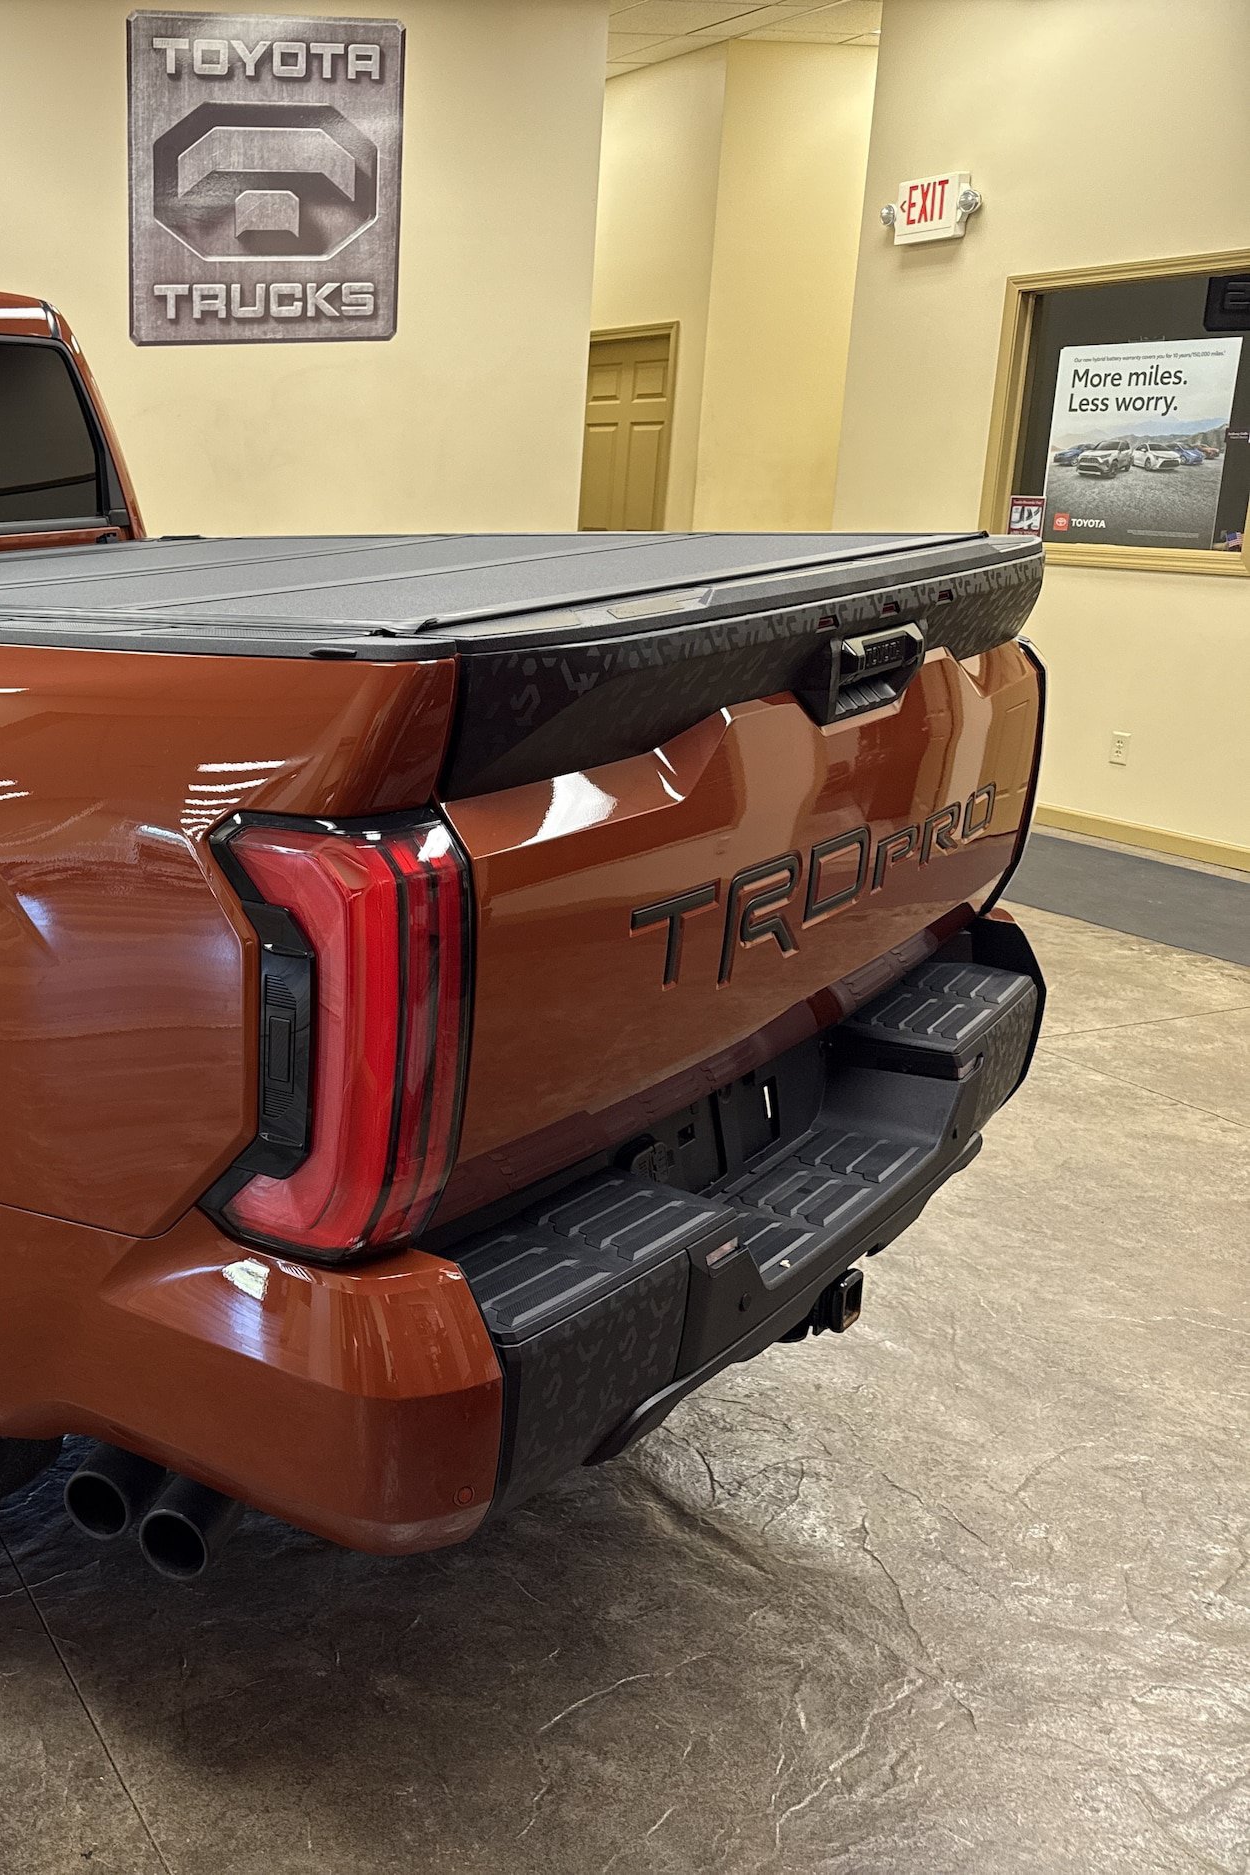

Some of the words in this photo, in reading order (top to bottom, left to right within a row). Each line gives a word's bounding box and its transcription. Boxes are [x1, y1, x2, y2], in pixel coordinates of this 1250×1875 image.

[152, 37, 380, 80] TOYOTA
[906, 179, 949, 226] EXIT
[153, 282, 375, 320] TRUCKS
[1071, 369, 1122, 388] More
[1127, 365, 1188, 387] miles.
[1068, 393, 1109, 412] Less
[1116, 395, 1178, 416] worry.
[1071, 518, 1106, 528] TOYOTA
